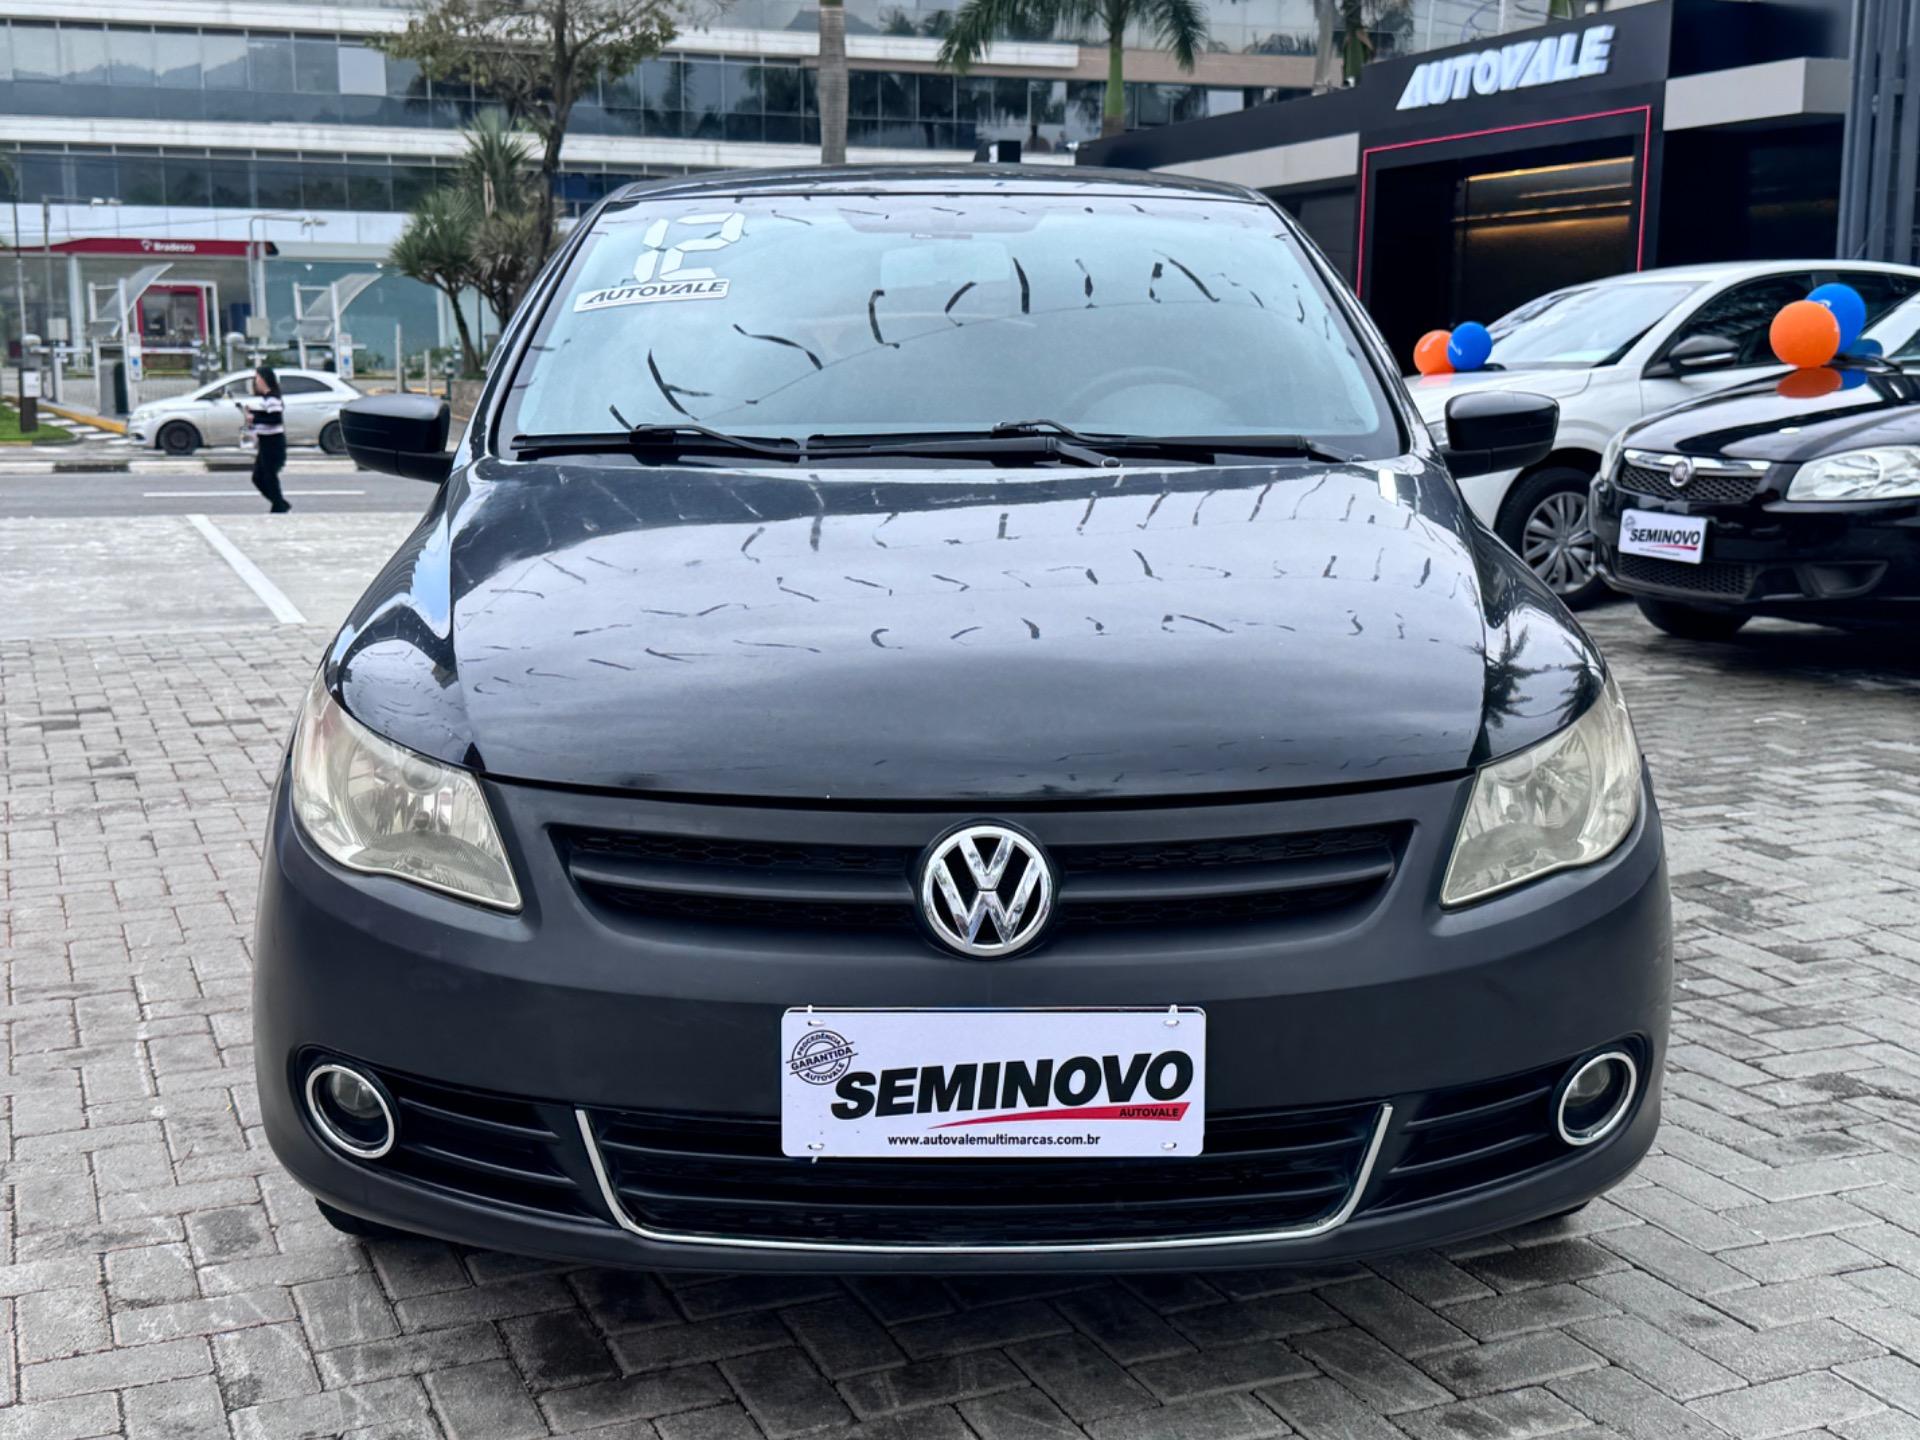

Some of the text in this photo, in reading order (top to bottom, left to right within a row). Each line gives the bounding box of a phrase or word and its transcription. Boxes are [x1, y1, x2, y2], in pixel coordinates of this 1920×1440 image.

[1395, 24, 1616, 111] AUTOVALE
[153, 242, 196, 253] Bradesco
[633, 211, 746, 284] 12
[584, 281, 727, 304] AUTOVALE
[1629, 528, 1701, 545] SEMINOVO
[790, 1046, 854, 1071] GARANTIDA
[804, 1061, 845, 1082] AUTOVALE
[830, 1050, 1194, 1120] SEMINOVO
[1119, 1107, 1179, 1118] AUTOVALE
[887, 1133, 1101, 1146] www.autovalemultimarcas.com.br
